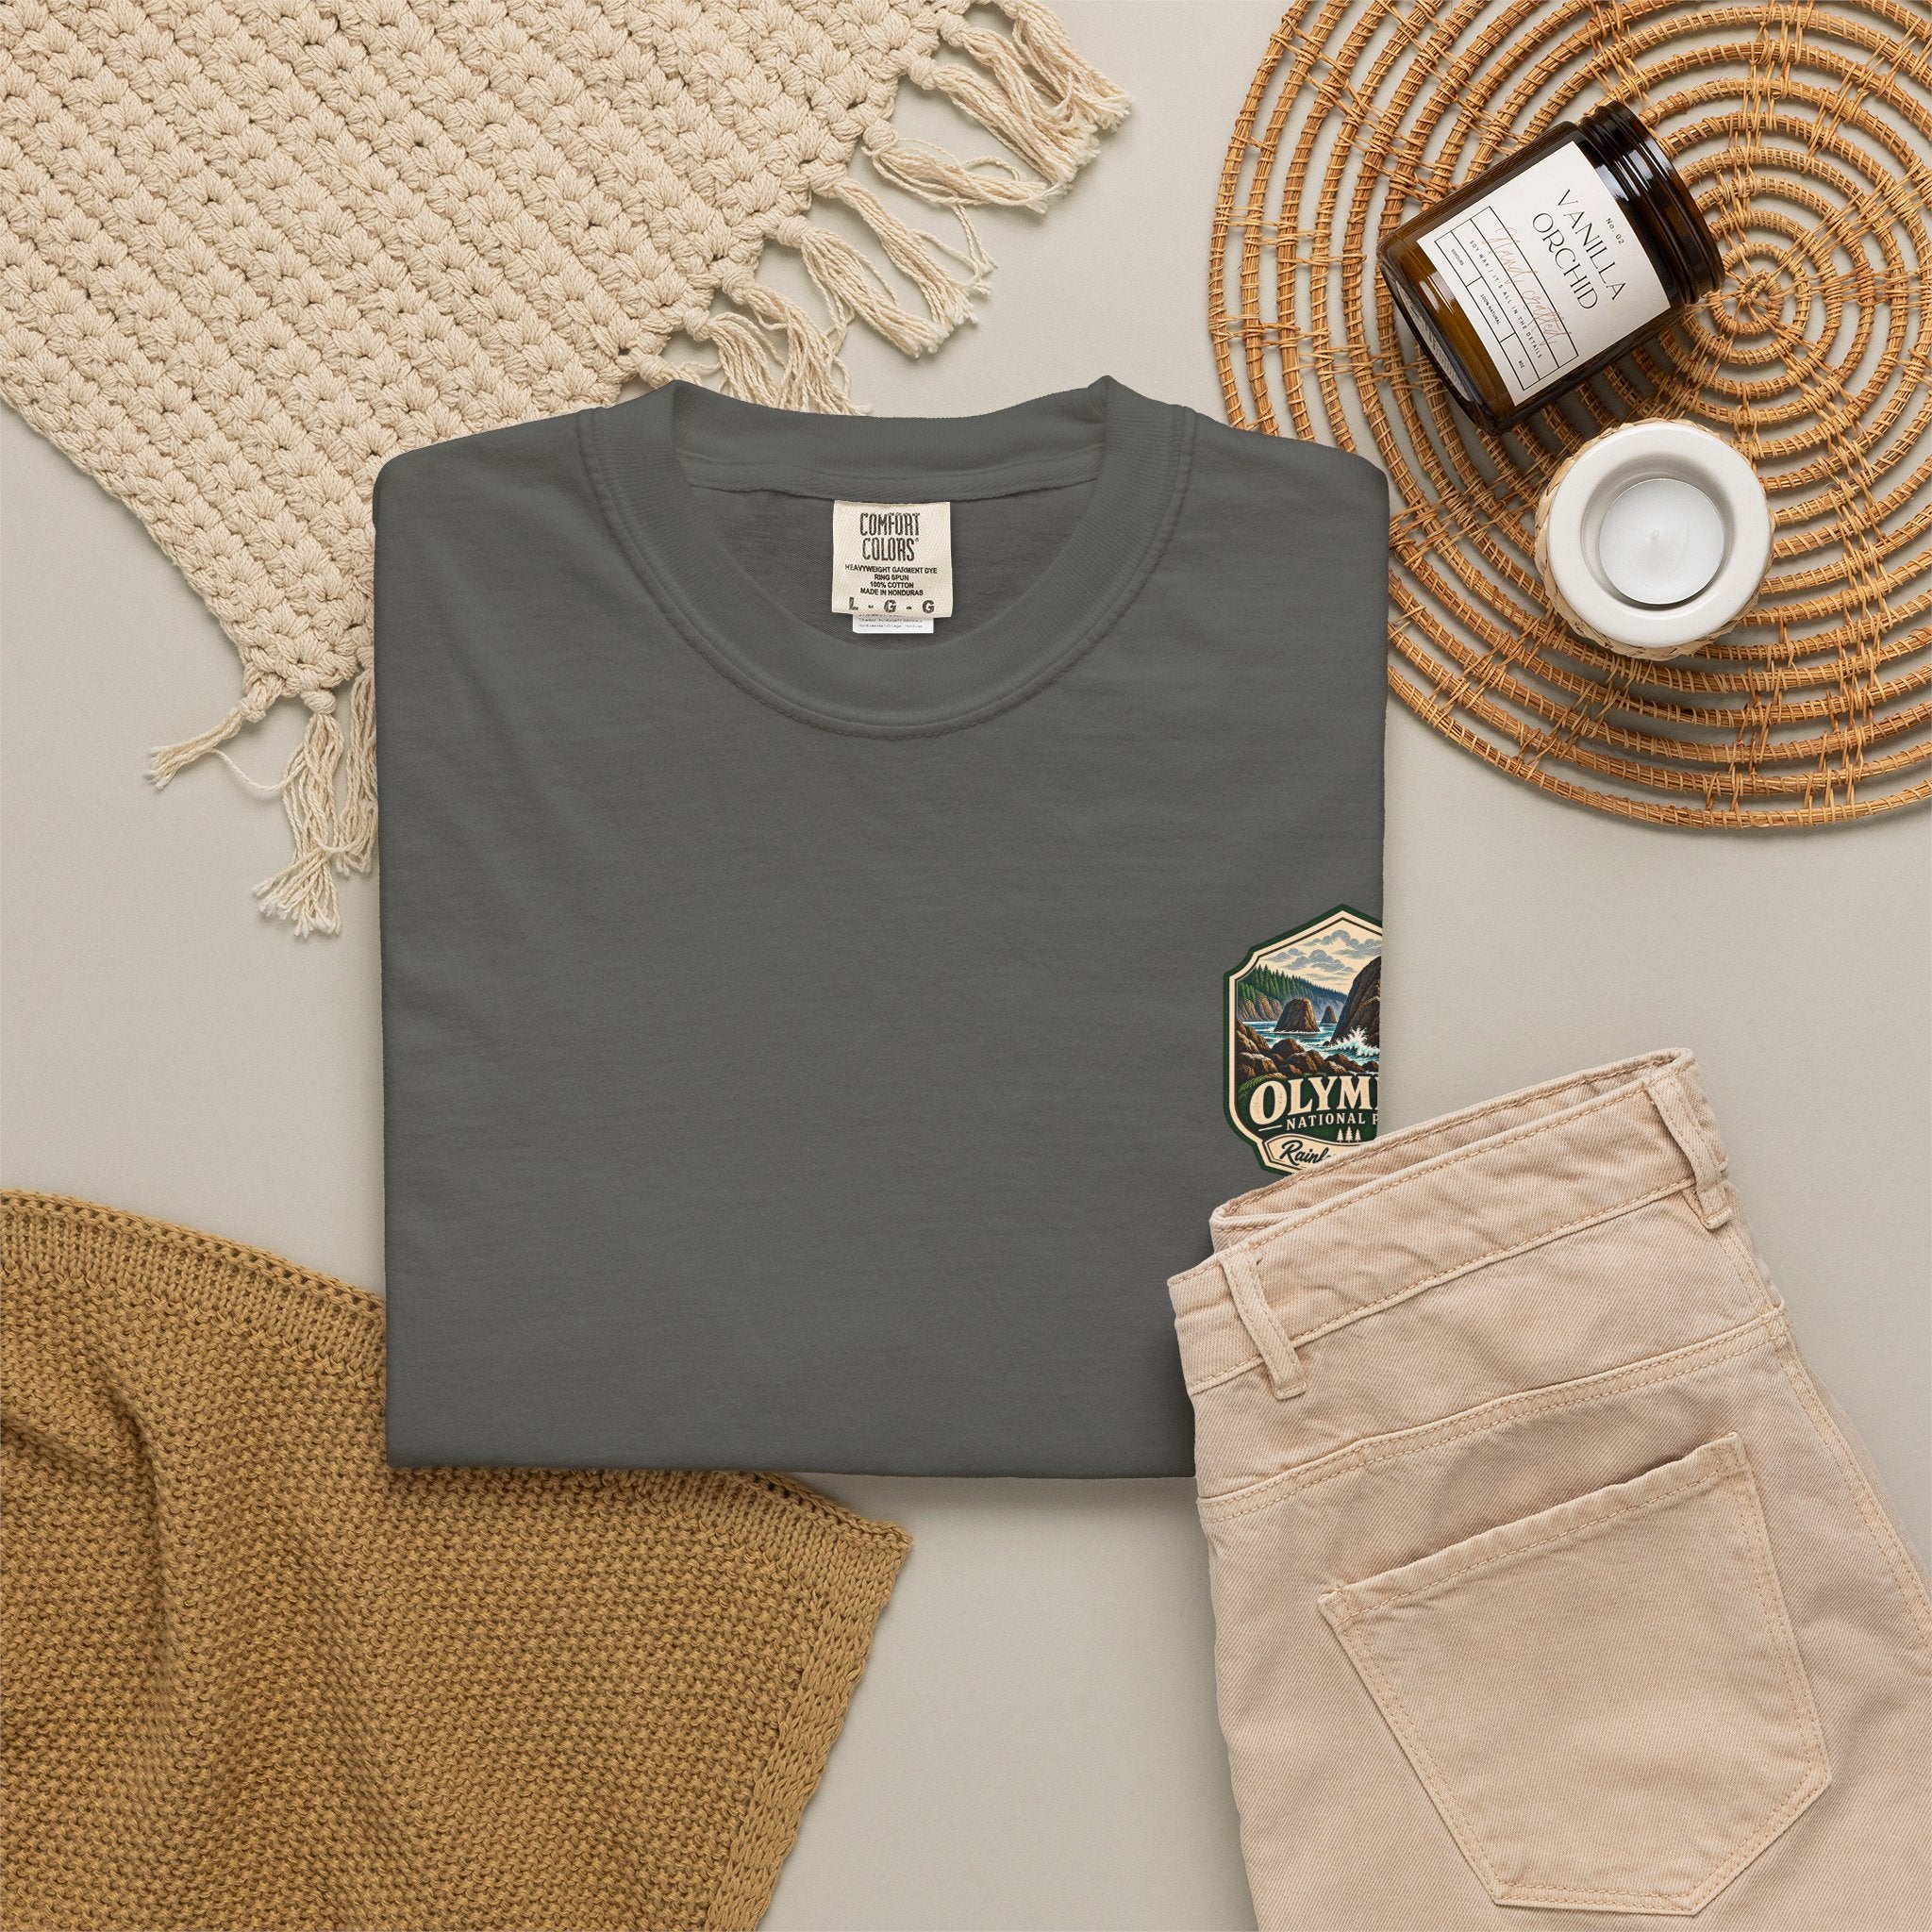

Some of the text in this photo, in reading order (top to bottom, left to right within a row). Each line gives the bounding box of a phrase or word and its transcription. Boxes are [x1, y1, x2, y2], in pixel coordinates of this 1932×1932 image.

[1606, 217, 1624, 245] No. 02
[1481, 226, 1539, 285] Hand
[1557, 189, 1626, 301] VANILLA
[1532, 212, 1598, 309] ORCHID
[1469, 240, 1480, 252] SOY
[1478, 253, 1490, 267] WAX
[1492, 275, 1504, 289] IT'S
[1503, 291, 1512, 305] ALL
[1511, 306, 1518, 315] IN
[1518, 316, 1528, 330] THE
[1525, 331, 1542, 358] DETAILS
[1488, 305, 1501, 325] NATURAL
[859, 512, 921, 536] COMFORT
[844, 563, 891, 574] HEAVYWEIGHT
[859, 587, 879, 596] MADE
[848, 596, 859, 611] L
[883, 599, 896, 613] G
[922, 599, 935, 614] G
[1249, 1075, 1378, 1125] OLYM
[1286, 1112, 1366, 1131] NATIONAL
